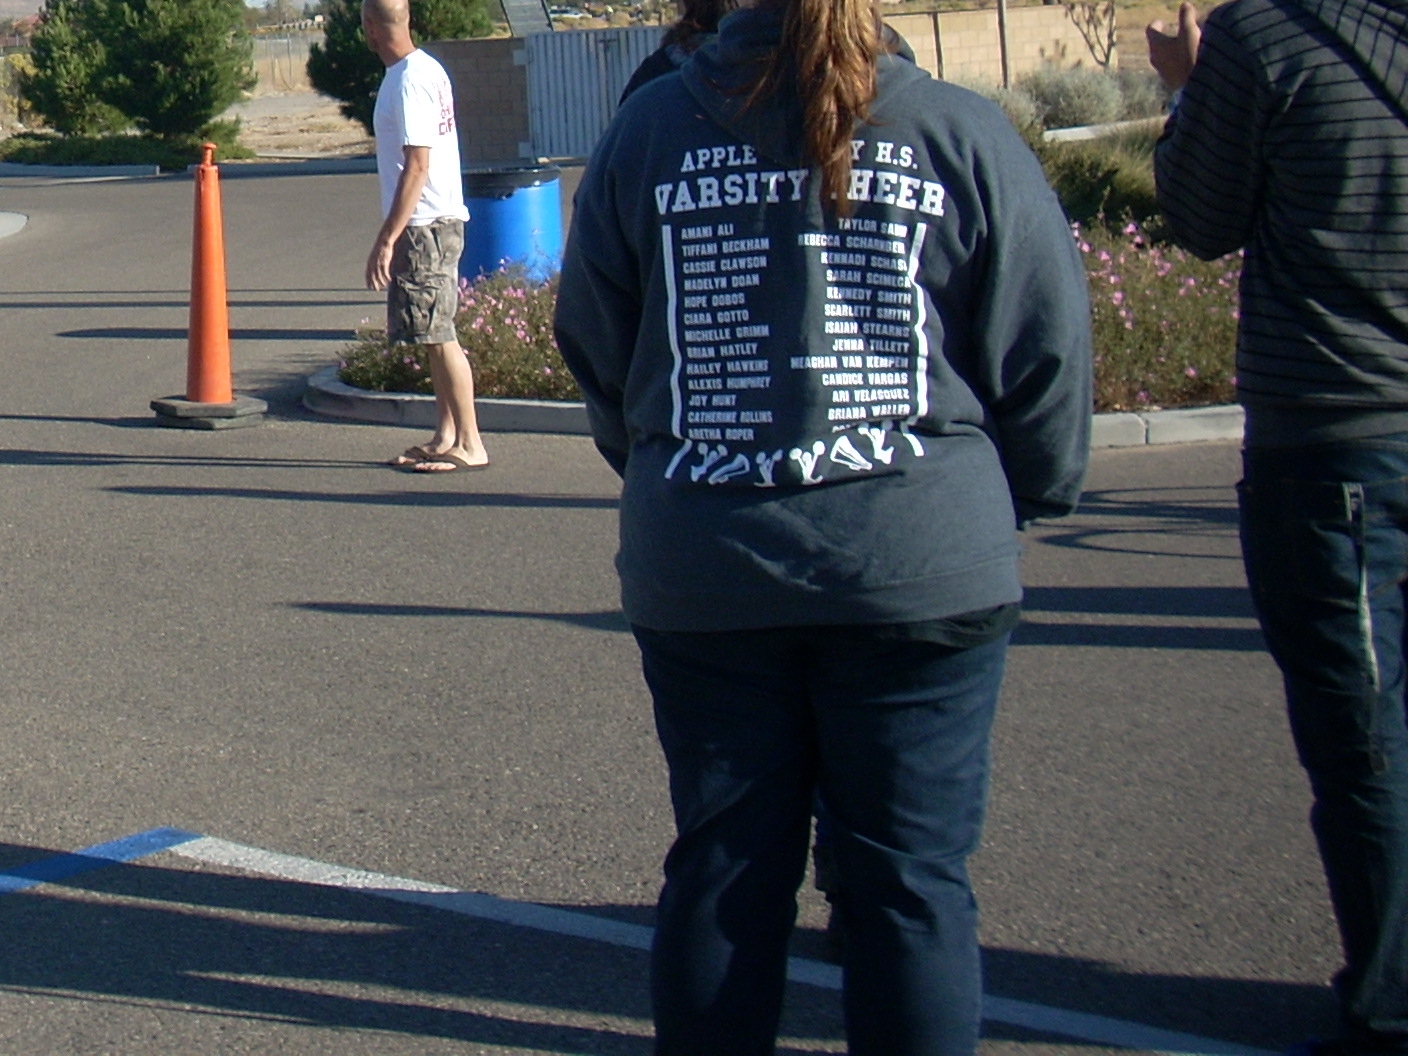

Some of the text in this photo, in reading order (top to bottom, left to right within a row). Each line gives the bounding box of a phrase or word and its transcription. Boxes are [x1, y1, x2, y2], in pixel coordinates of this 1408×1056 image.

[681, 144, 757, 173] APPLE
[875, 141, 918, 170] H.S.
[654, 169, 945, 217] VARSITY HEER
[717, 223, 734, 236] ALI
[838, 217, 877, 232] TAYLOR
[682, 237, 770, 257] TIFFANI BECKHAM
[797, 233, 841, 248] REBECCA
[683, 255, 767, 275] CASSIE CLAWSON
[826, 269, 862, 283] SARAH
[826, 286, 912, 305] KENNEDY SMITH
[824, 303, 911, 322] SCARLETT SMITH
[684, 327, 731, 342] MICHELLE
[824, 321, 858, 334] ISAIAH
[842, 355, 863, 369] VAN
[688, 377, 723, 391] ALEXIS
[867, 372, 908, 385] VARGAS
[689, 394, 708, 407] JOY
[832, 390, 850, 403] ARI
